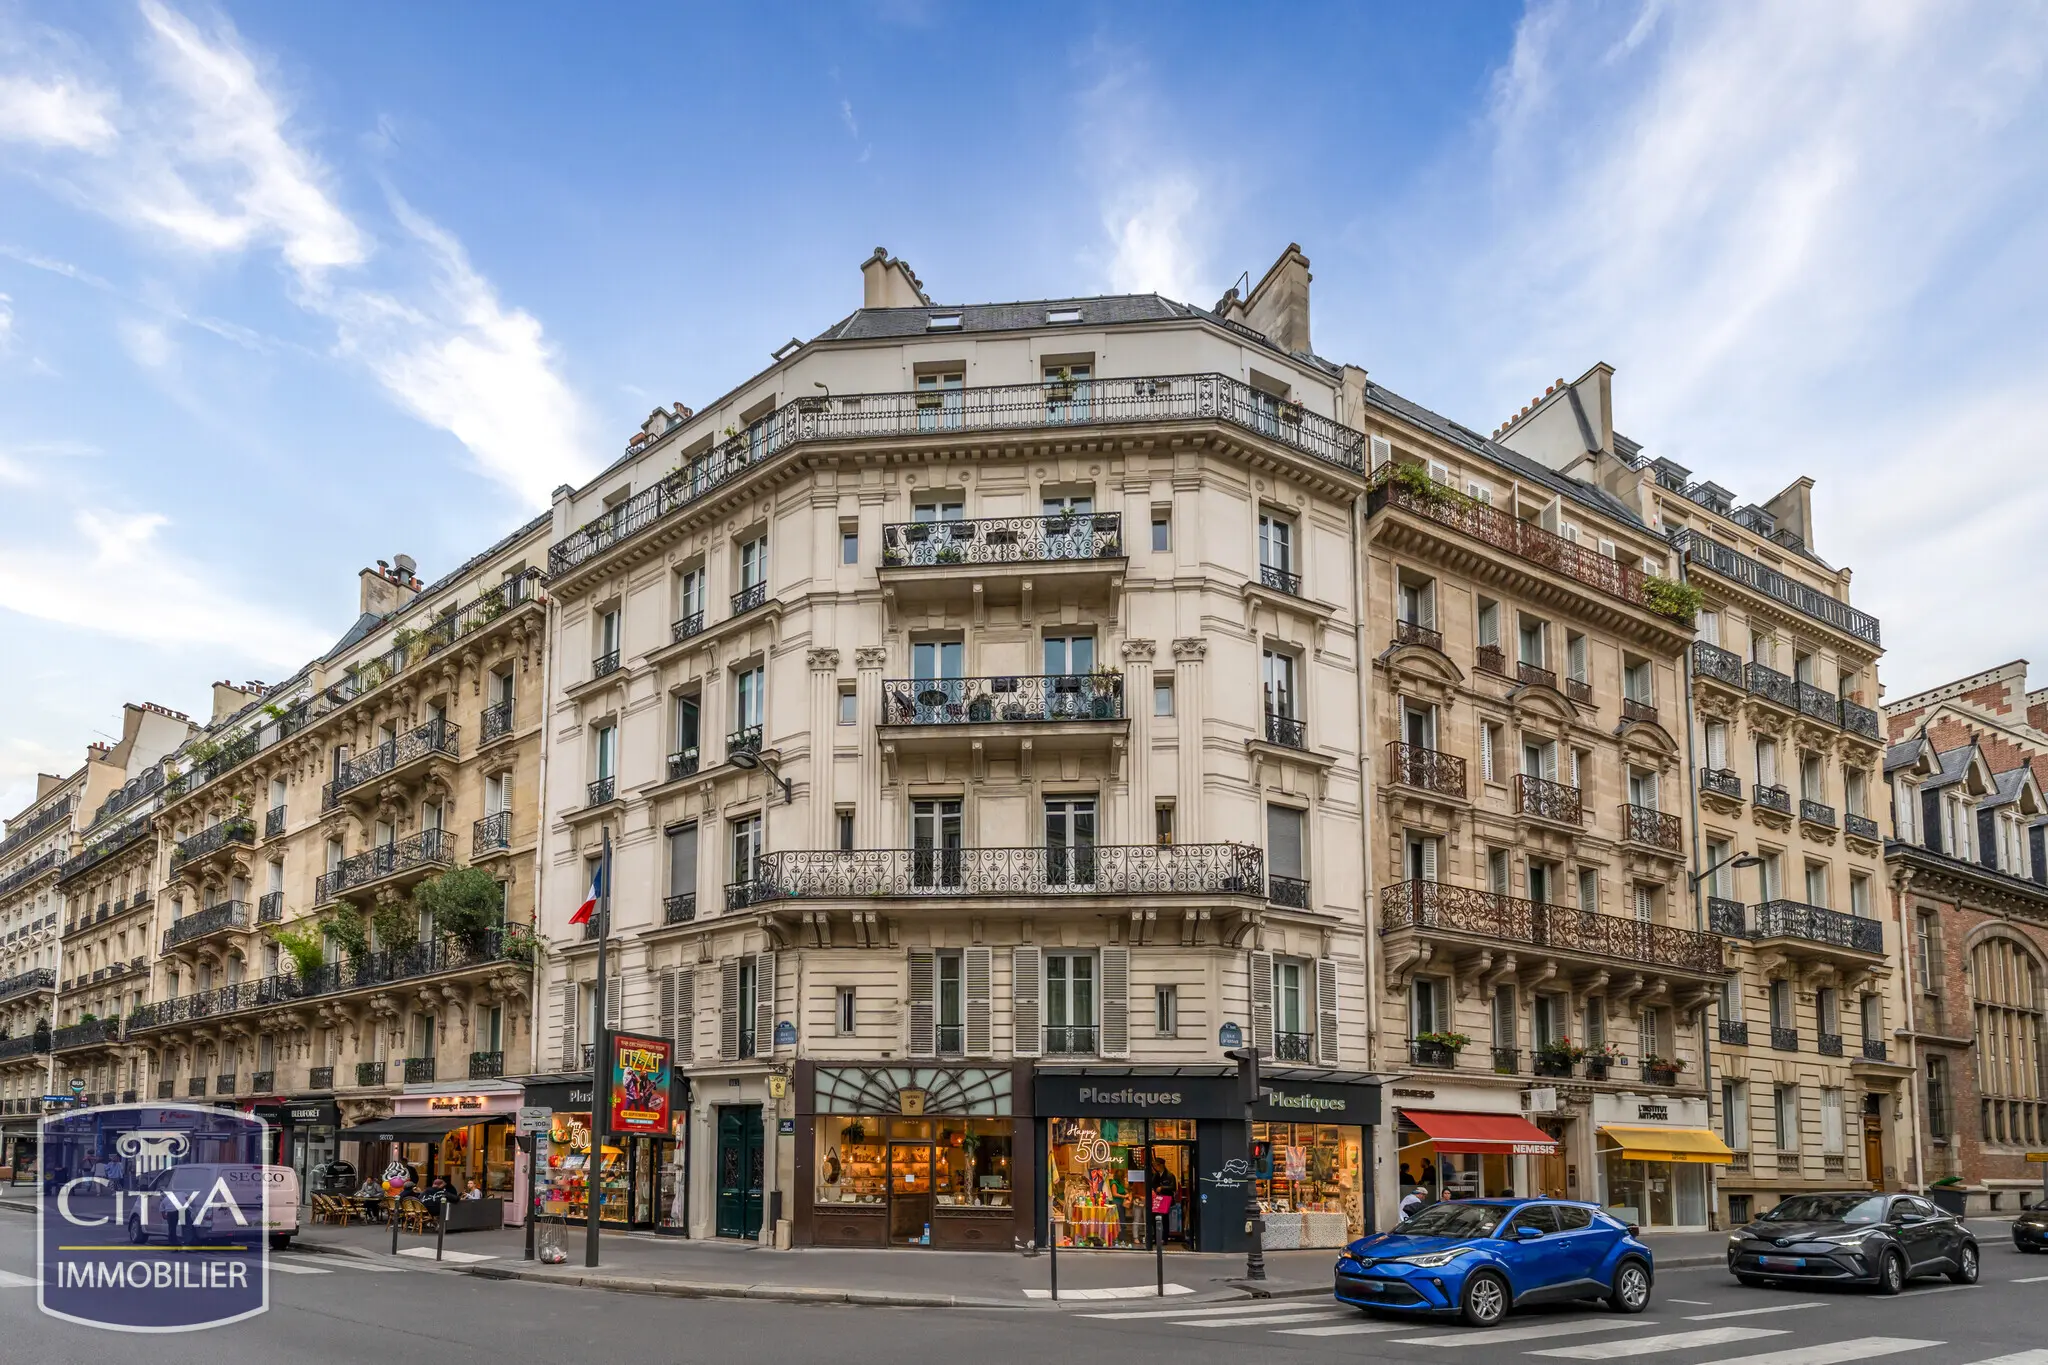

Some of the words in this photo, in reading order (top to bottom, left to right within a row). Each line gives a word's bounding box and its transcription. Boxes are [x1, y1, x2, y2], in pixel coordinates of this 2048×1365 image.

[1079, 1088, 1182, 1108] Plastiques
[1392, 1088, 1436, 1099] NEMESIS
[431, 1101, 458, 1113] Boulanger
[459, 1100, 482, 1110] Pâtissier
[1269, 1091, 1347, 1113] Plastiques
[291, 1108, 320, 1118] BLEUFORÊT
[1638, 1105, 1668, 1113] L'INSTITUT
[1638, 1113, 1668, 1121] ANTI-POUX
[1066, 1124, 1097, 1139] Happy
[570, 1128, 588, 1148] 50
[1074, 1138, 1110, 1163] 50
[1513, 1144, 1555, 1154] NEMESIS
[229, 1172, 285, 1182] SECCO
